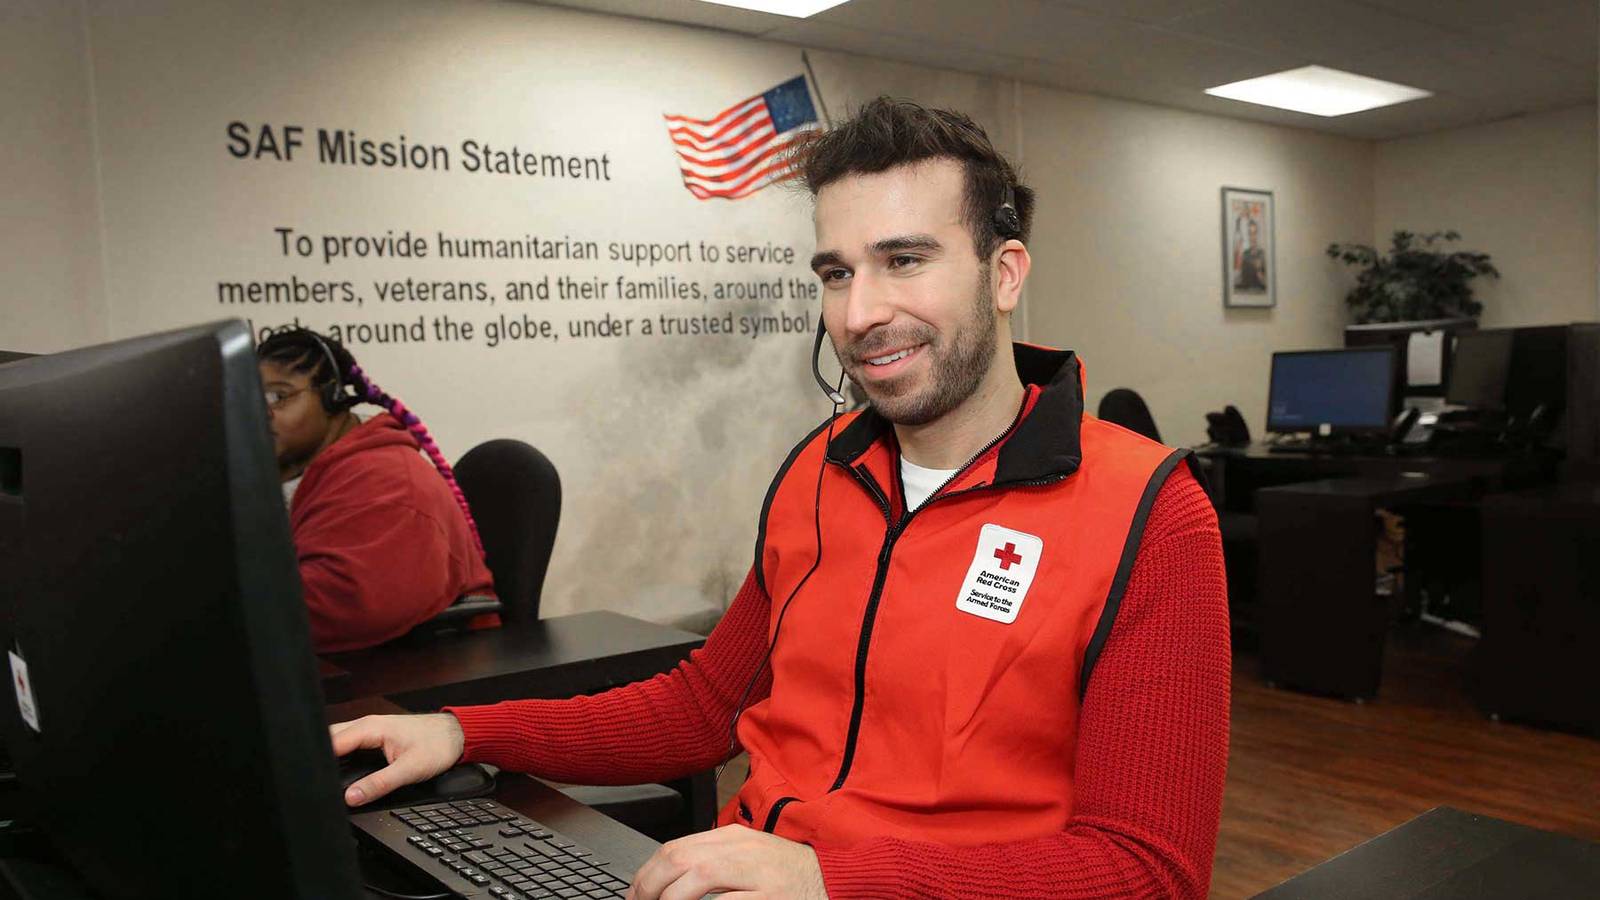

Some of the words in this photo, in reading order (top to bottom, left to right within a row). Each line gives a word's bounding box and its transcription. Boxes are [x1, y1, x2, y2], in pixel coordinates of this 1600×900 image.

[226, 121, 304, 161] SAF
[317, 128, 450, 171] Mission
[461, 139, 612, 181] Statement
[274, 227, 313, 257] To
[322, 230, 428, 265] provide
[437, 232, 599, 260] humanitarian
[608, 240, 692, 268] support
[699, 240, 720, 263] to
[726, 241, 795, 265] service
[217, 275, 364, 307] members,
[373, 276, 496, 305] veterans,
[505, 275, 550, 302] and
[556, 275, 609, 300] their
[616, 276, 708, 302] families,
[714, 277, 784, 300] around
[788, 277, 818, 300] the
[328, 315, 426, 345] around
[432, 315, 475, 342] the
[484, 314, 560, 348] globe,
[568, 312, 634, 338] under
[641, 318, 654, 336] a
[658, 311, 734, 336] trusted
[739, 308, 816, 340] symbol.
[976, 576, 993, 587] Red
[993, 582, 1017, 594] Cross
[980, 570, 1020, 587] American
[966, 596, 989, 608] Armed
[989, 602, 1011, 614] Forces
[970, 588, 994, 602] Service
[994, 596, 1001, 604] to
[1002, 597, 1013, 607] the
